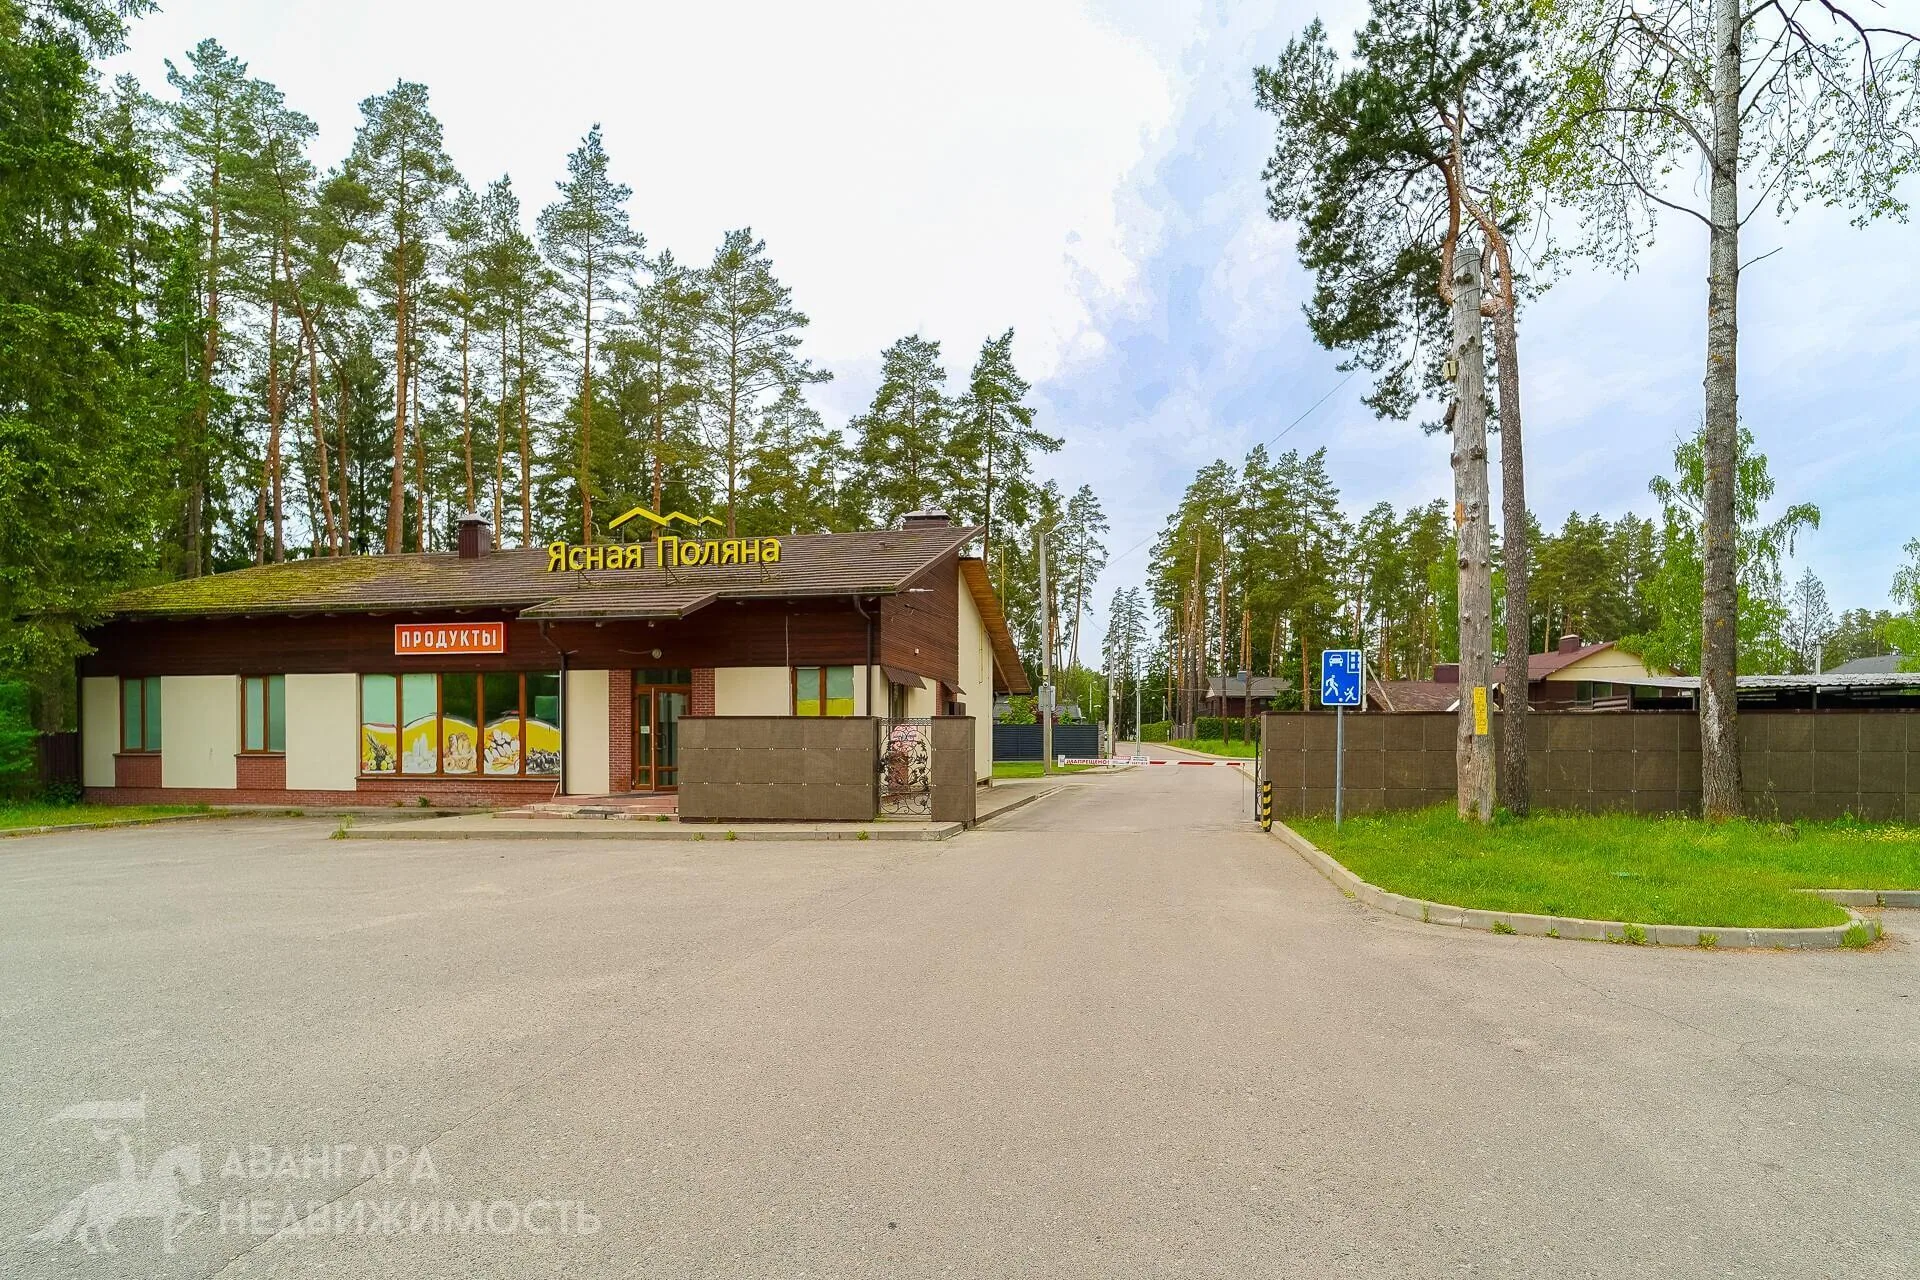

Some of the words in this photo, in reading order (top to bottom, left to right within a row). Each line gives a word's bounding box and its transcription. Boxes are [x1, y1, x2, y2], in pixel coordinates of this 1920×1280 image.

[547, 541, 643, 572] Ясная
[657, 536, 781, 567] Поляна
[401, 629, 497, 649] ПРОДУКТЫ
